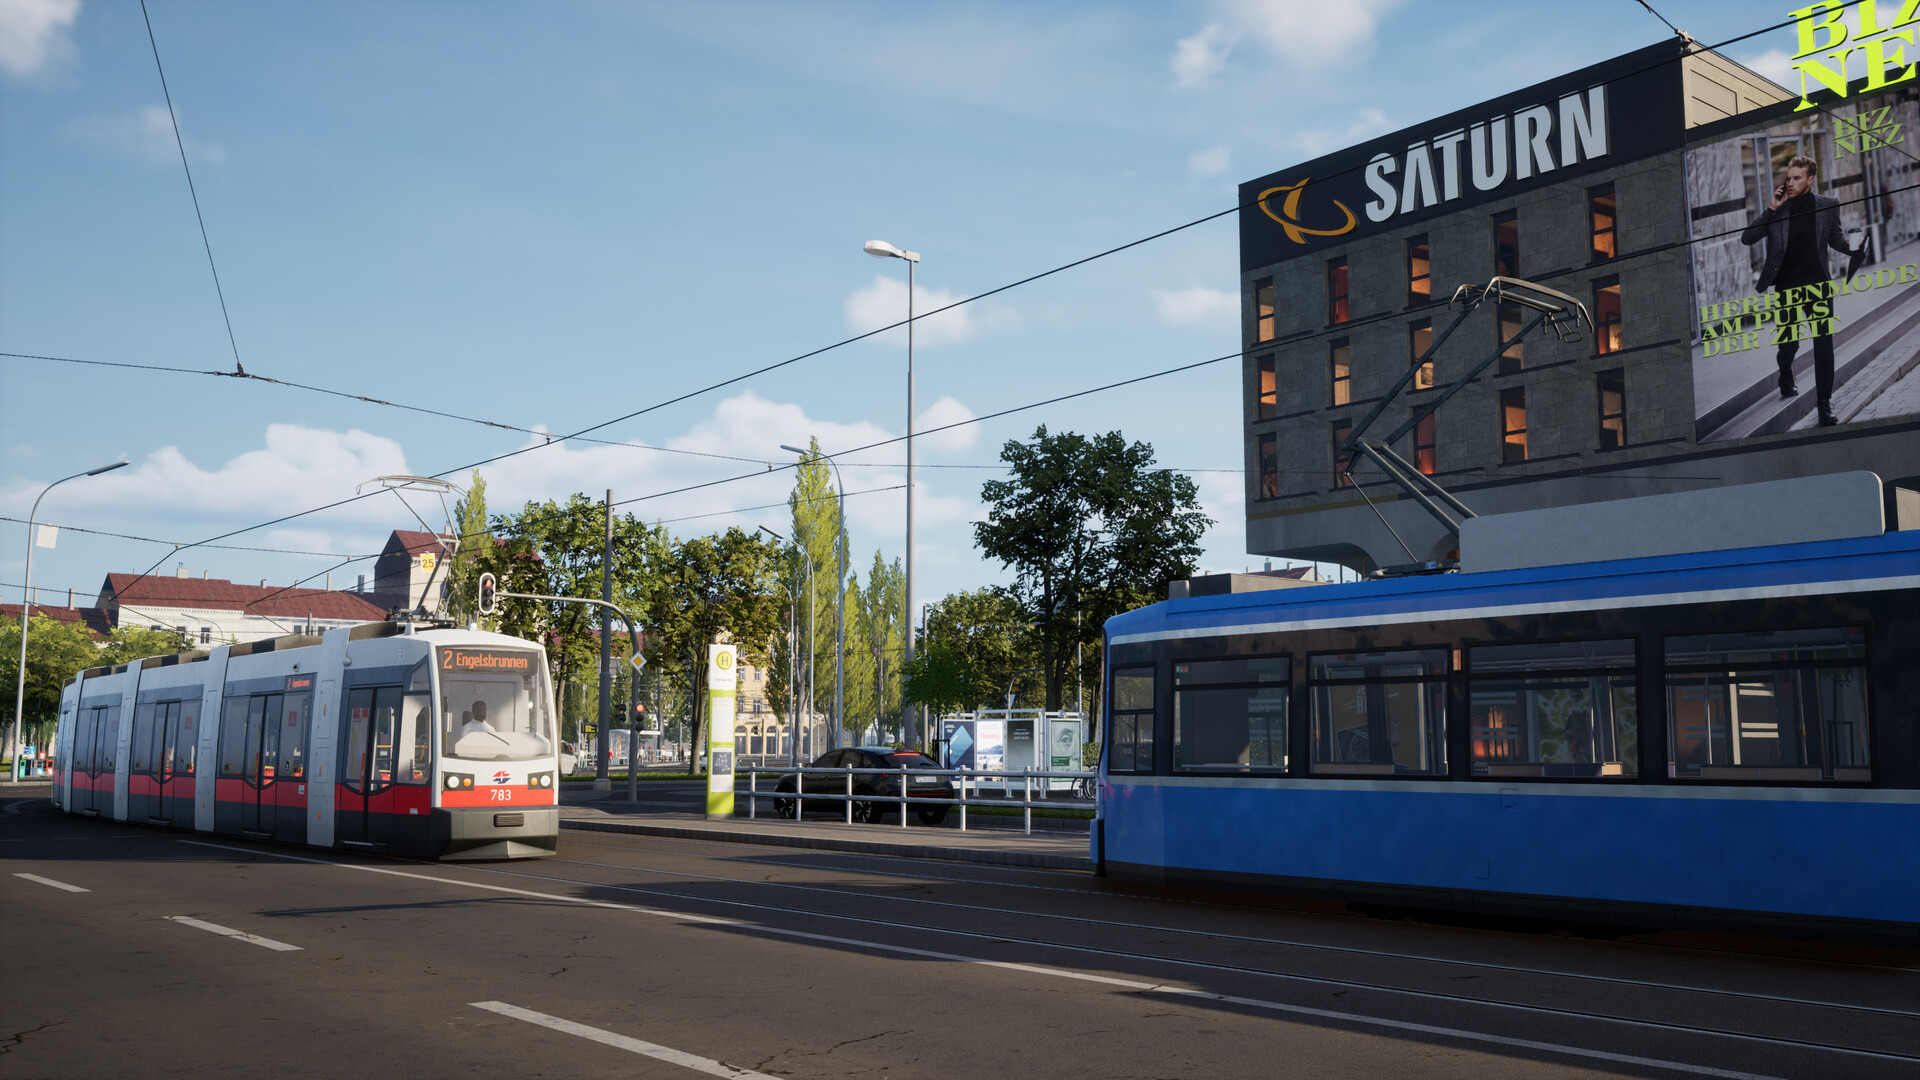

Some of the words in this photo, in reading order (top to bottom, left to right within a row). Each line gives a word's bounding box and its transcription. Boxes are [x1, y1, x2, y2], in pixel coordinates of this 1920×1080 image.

[1791, 26, 1920, 112] NE
[1832, 105, 1894, 140] BIZ
[1833, 122, 1904, 159] NEZ
[1365, 82, 1609, 222] SATURN
[1699, 263, 1919, 324] HERRENMODE
[1701, 316, 1744, 341] AM
[1753, 300, 1830, 332] PULS
[1701, 332, 1760, 359] DER
[1770, 315, 1841, 346] ZEIT
[422, 559, 434, 568] 25
[443, 650, 453, 669] 2
[456, 652, 528, 669] Engelsbrunnen
[721, 655, 729, 666] H
[490, 789, 512, 801] 783
